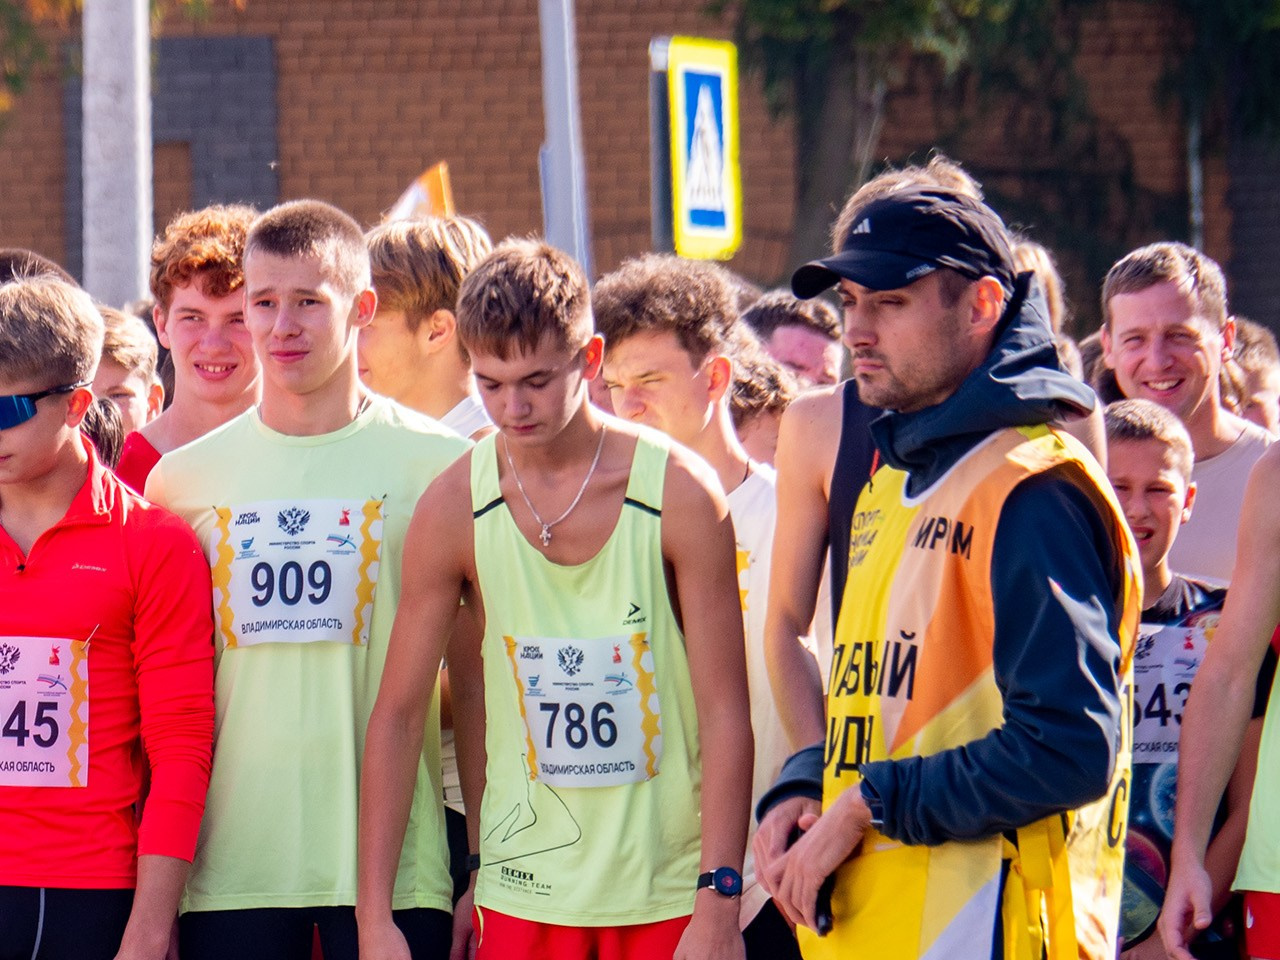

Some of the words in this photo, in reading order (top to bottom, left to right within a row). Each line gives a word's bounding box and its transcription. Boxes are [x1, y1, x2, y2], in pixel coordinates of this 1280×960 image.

[251, 560, 332, 608] 909
[241, 618, 305, 634] ВЛАДИМИРСКАЯ
[306, 617, 342, 630] ОБЛАСТЬ
[539, 702, 618, 750] 786
[16, 761, 55, 773] ОБЛАСТЬ
[596, 760, 635, 774] ОБЛАСТЬ
